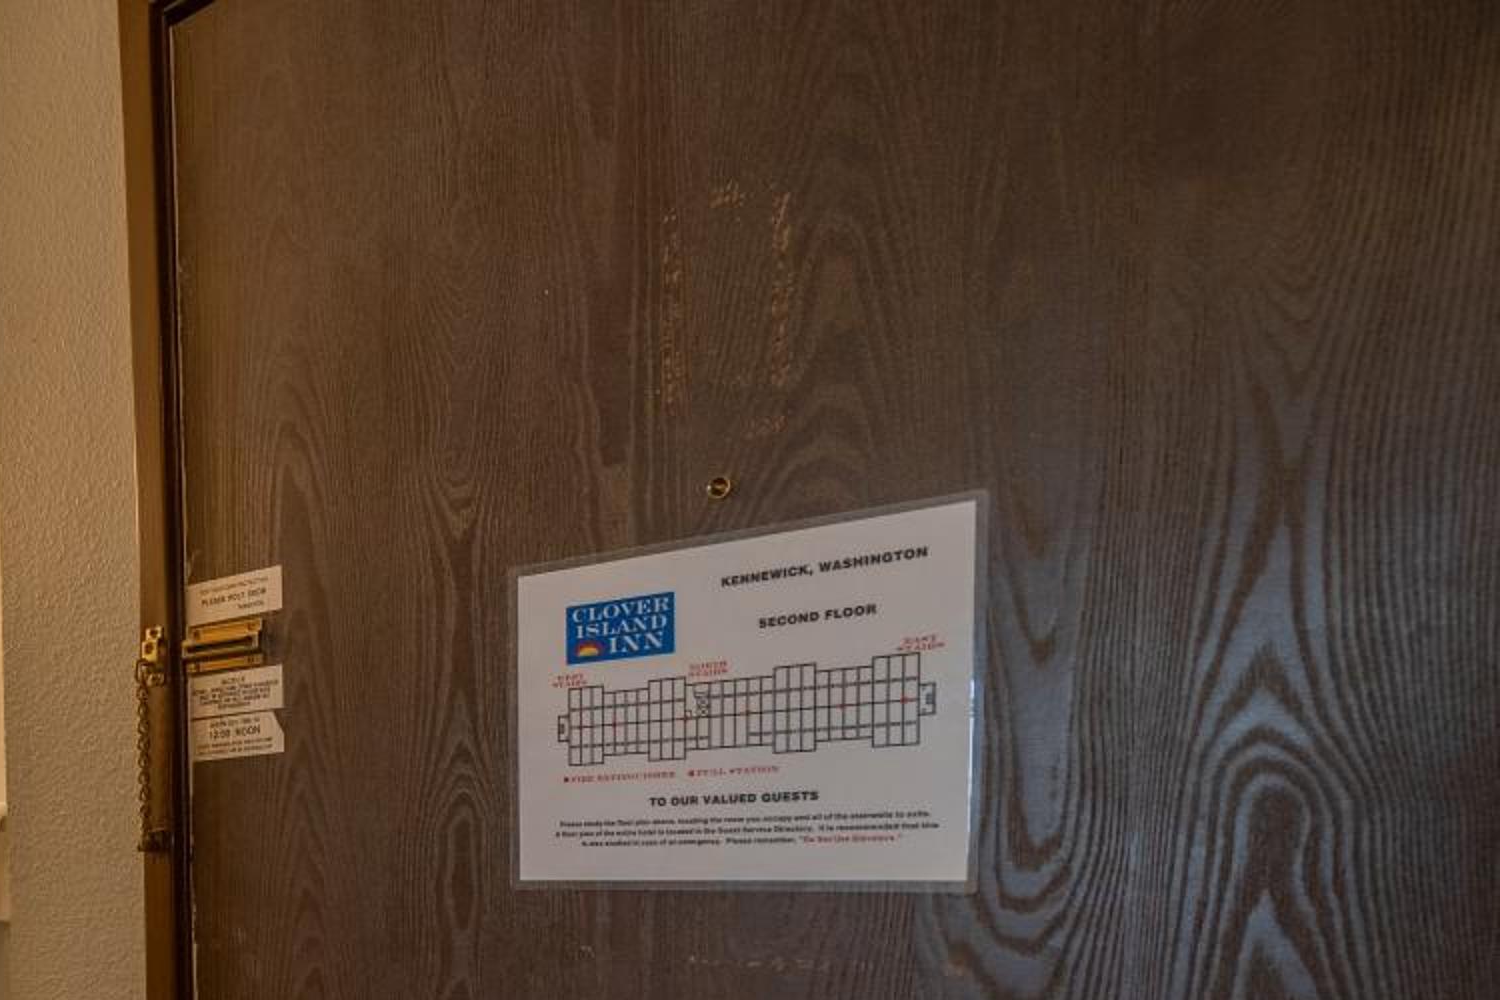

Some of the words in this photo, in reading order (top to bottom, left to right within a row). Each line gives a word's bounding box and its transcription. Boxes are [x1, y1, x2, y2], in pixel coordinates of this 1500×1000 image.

[721, 564, 813, 587] KENNEWICK,
[819, 547, 929, 572] WASHINGTON
[572, 597, 669, 623] CLOVER
[759, 611, 820, 628] SECOND
[825, 604, 877, 620] FLOOR
[576, 615, 667, 638] ISLAND
[609, 631, 663, 653] INN
[649, 797, 667, 807] TO
[671, 796, 699, 807] OUR
[703, 794, 757, 805] VALUED
[761, 791, 819, 803] GUESTS
